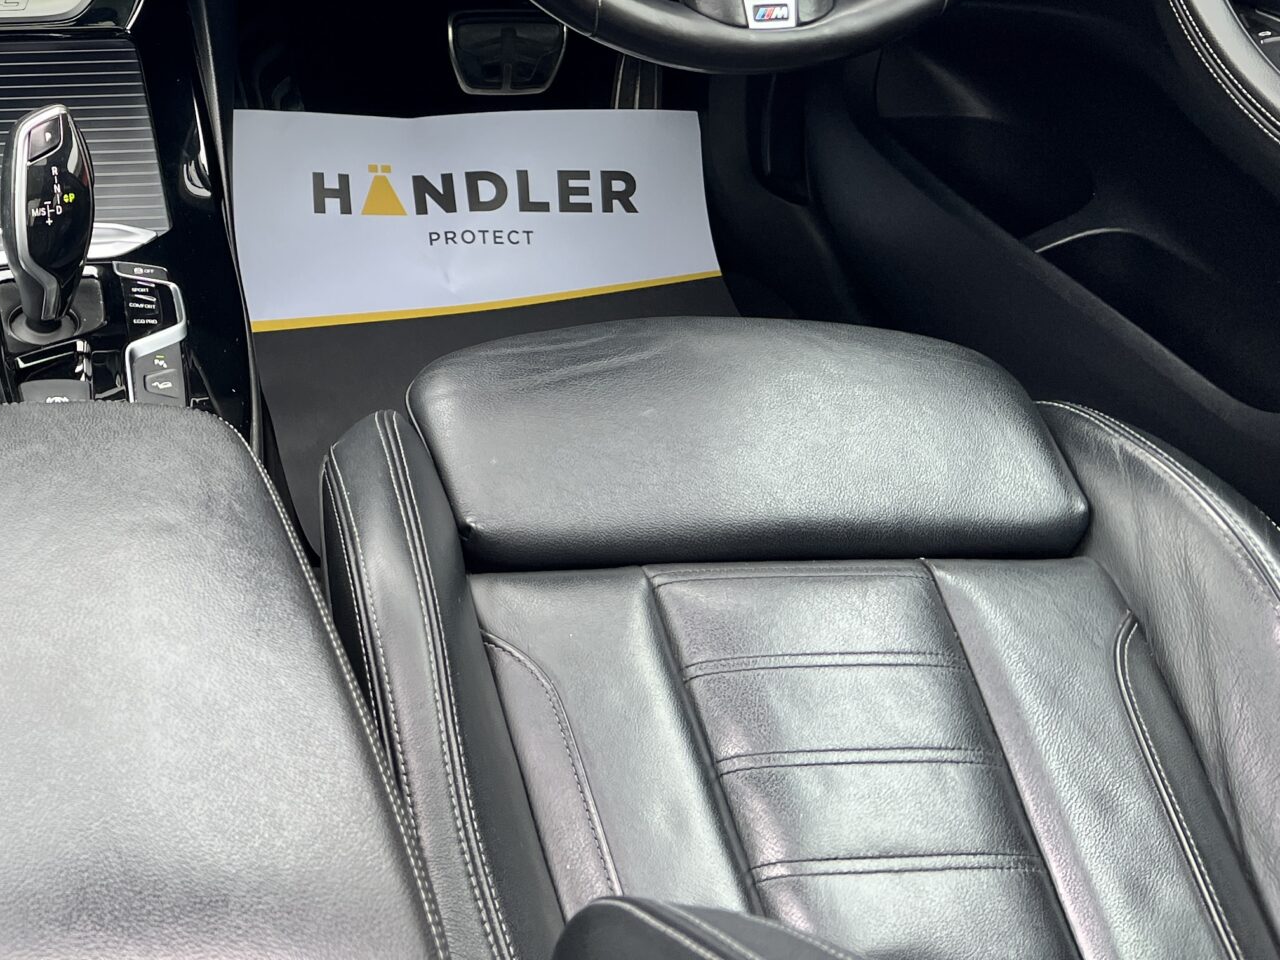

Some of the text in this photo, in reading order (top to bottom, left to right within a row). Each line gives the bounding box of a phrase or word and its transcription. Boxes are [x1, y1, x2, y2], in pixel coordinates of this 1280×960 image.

[45, 131, 52, 142] P
[51, 166, 59, 176] R
[53, 183, 61, 193] N
[311, 163, 639, 216] HÄNDLER
[31, 208, 47, 217] M/S
[55, 205, 63, 215] D
[428, 229, 534, 246] PROTECT
[128, 302, 156, 310] COMFORT
